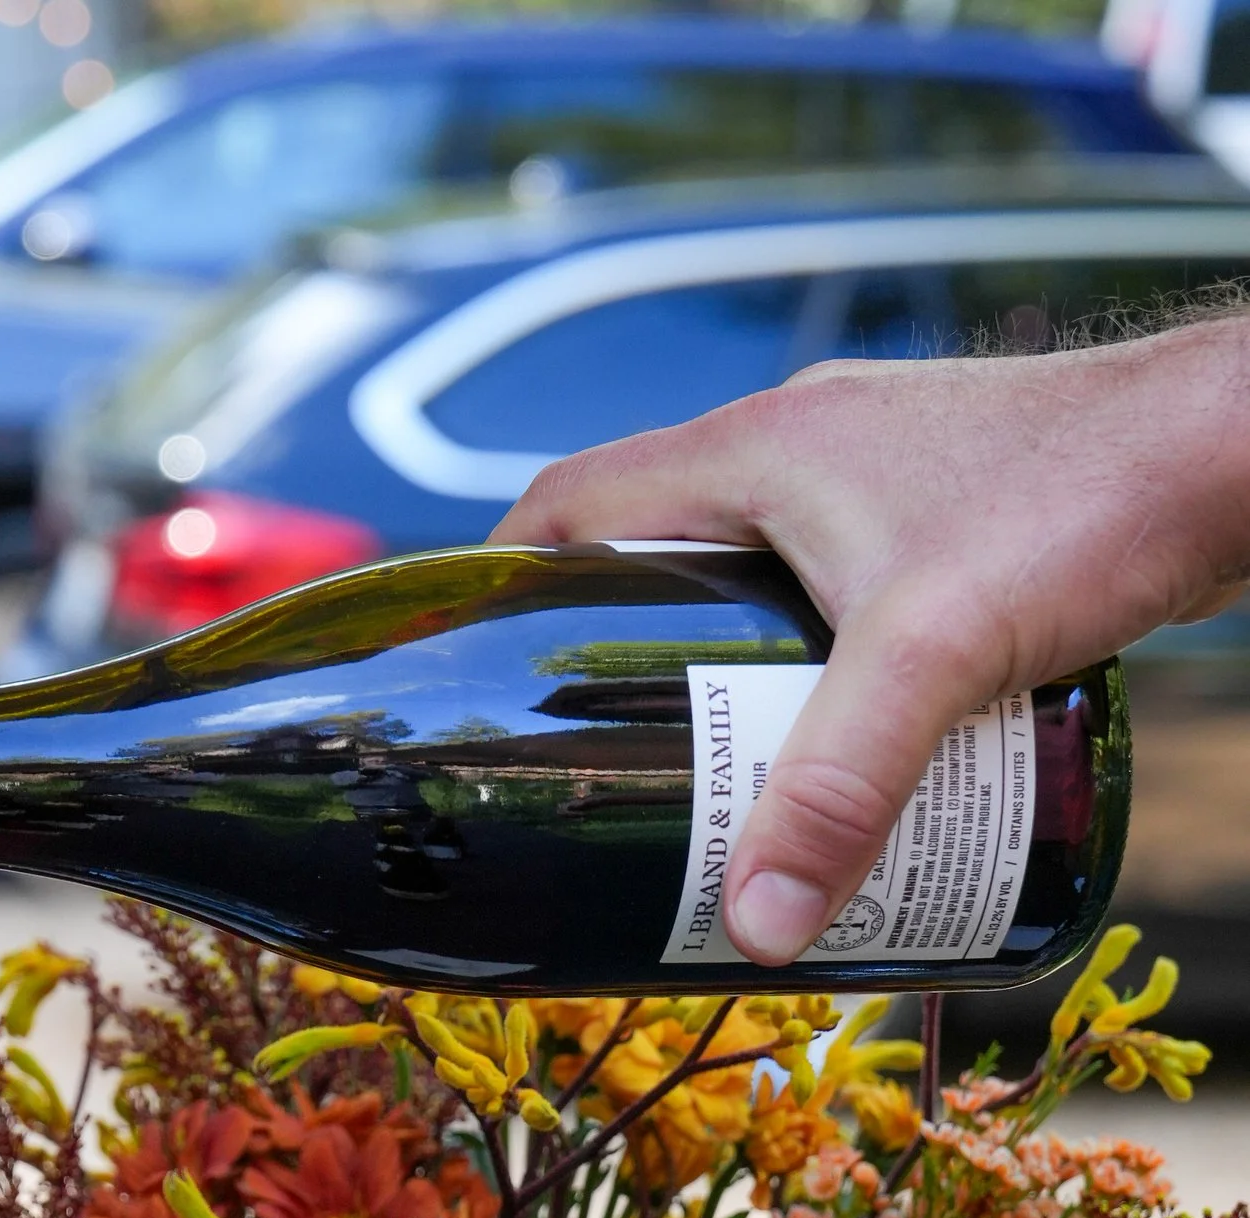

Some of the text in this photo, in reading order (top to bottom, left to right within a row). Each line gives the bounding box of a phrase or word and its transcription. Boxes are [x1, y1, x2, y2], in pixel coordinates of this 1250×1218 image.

[1011, 701, 1023, 720] 750
[964, 724, 976, 759] OPERATE
[948, 738, 960, 796] CONSUMPTION
[965, 762, 976, 773] OR
[1013, 751, 1025, 799] SULFITES
[916, 785, 928, 796] TO
[932, 765, 944, 811] BEVERAGES
[964, 774, 976, 791] CAR
[946, 799, 960, 811] (2)
[962, 800, 974, 823] DRIVE
[681, 681, 732, 953] I. BRAND & FAMILY
[912, 801, 927, 845] ACCORDING
[1008, 801, 1024, 850] CONTAINS
[926, 814, 942, 856] ALCOHOLIC
[943, 814, 958, 850] DEFECTS.
[961, 826, 972, 836] TO
[940, 851, 953, 873] BIRTH
[958, 838, 970, 866] ABILITY
[922, 860, 936, 882] DRINK
[947, 782, 992, 947] MACHINERY, AND MAY CAUSE HEALTH PROBLEMS.
[901, 864, 919, 902] WARNING:
[938, 874, 949, 884] OF
[953, 867, 967, 886] YOUR
[1000, 876, 1013, 897] VOL.
[918, 885, 931, 899] NOT
[933, 885, 947, 901] RISK
[945, 888, 962, 916] IMPAIRS
[910, 901, 927, 926] SHOULD
[930, 902, 943, 914] THE
[995, 899, 1008, 909] BY
[885, 906, 910, 949] GOVERNMENT
[927, 915, 939, 924] OF
[989, 910, 1005, 930] 13.2%
[900, 928, 919, 948] WOMEN
[916, 924, 936, 948] BECAUSE
[932, 917, 954, 948] BEVERAGES
[981, 929, 997, 946] ALC.
